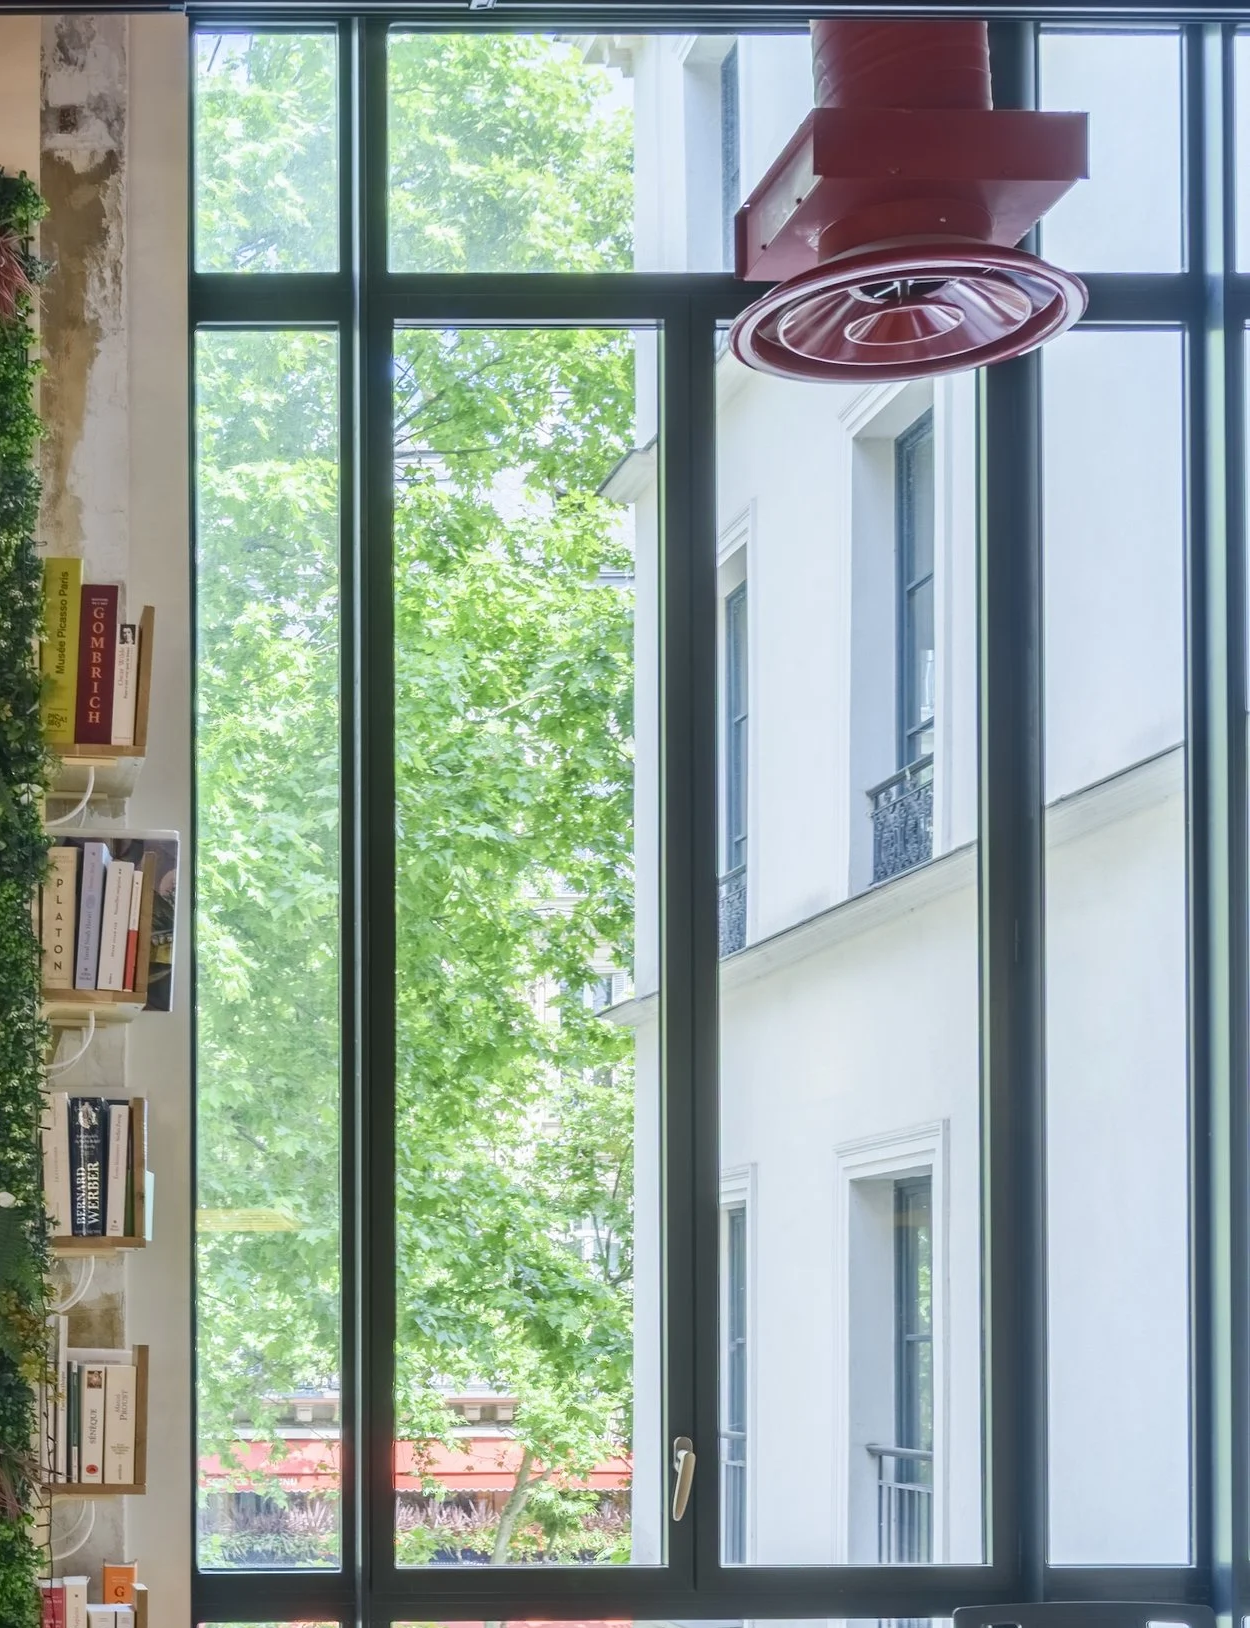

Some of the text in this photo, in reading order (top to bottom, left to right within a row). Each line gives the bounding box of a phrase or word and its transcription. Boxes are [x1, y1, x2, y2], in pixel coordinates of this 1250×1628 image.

[55, 571, 69, 674] Musée Picasso Paris
[88, 608, 105, 723] GOMBRICH
[54, 879, 63, 970] PLATON
[76, 1167, 86, 1225] BERNARD
[87, 1161, 100, 1225] WERBER
[88, 1409, 97, 1444] SÉNÈQUE
[120, 1389, 128, 1421] PROUST
